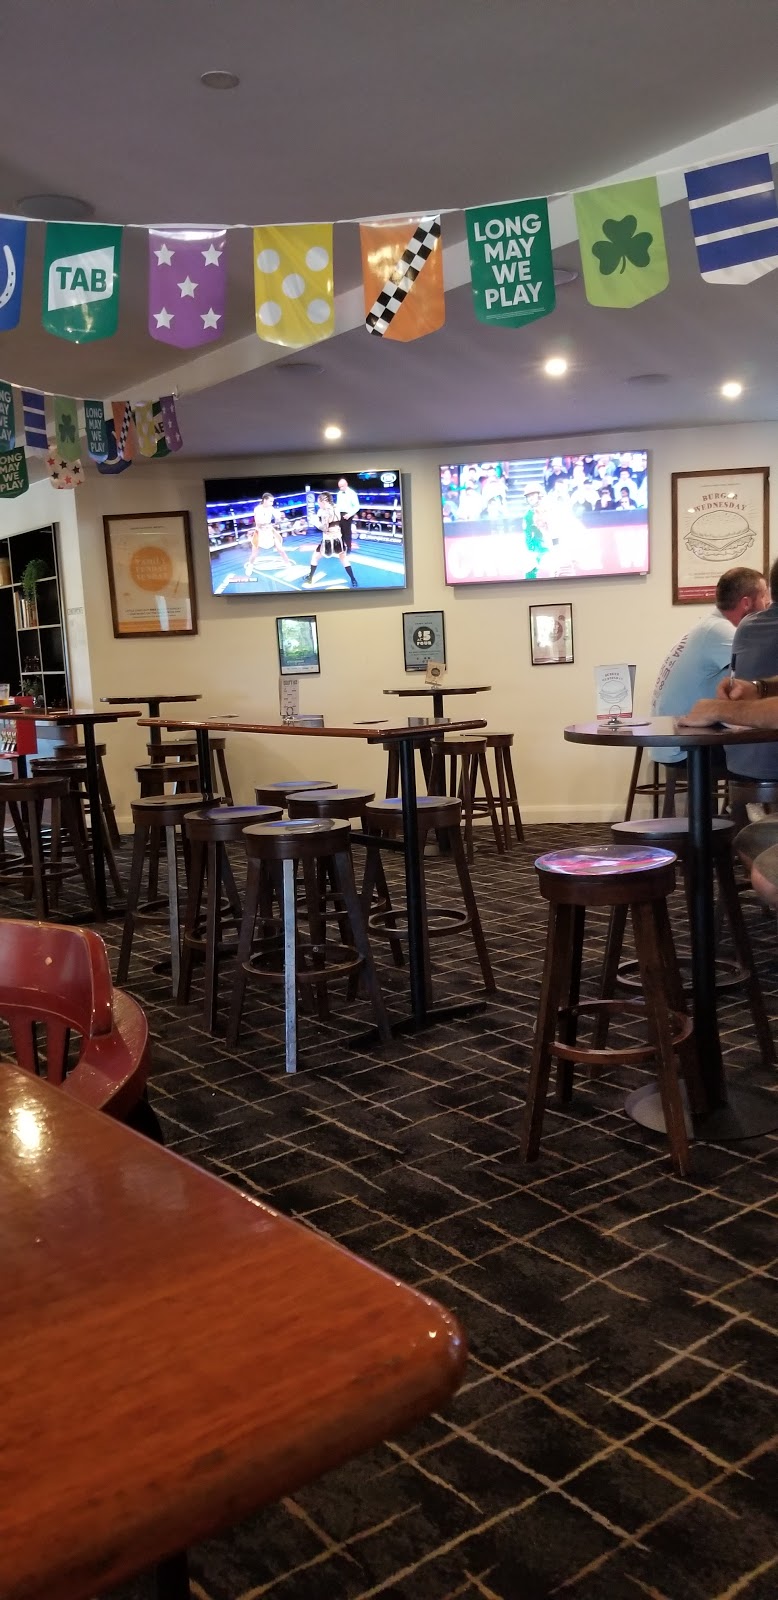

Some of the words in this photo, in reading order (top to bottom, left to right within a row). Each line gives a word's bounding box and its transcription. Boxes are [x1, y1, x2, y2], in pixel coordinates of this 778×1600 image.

[473, 213, 541, 242] LONG
[484, 236, 536, 263] MAY
[492, 260, 532, 285] WE
[55, 266, 108, 292] TAB
[485, 281, 543, 310] PLAY
[86, 407, 103, 419] LONG
[88, 419, 102, 430] MAY
[91, 430, 102, 441] WE
[90, 441, 105, 453] PLAY
[0, 453, 23, 465] ONG
[0, 462, 21, 475] MAY
[2, 471, 20, 483] WE
[0, 479, 25, 493] PLAY
[702, 492, 738, 502] BURGR
